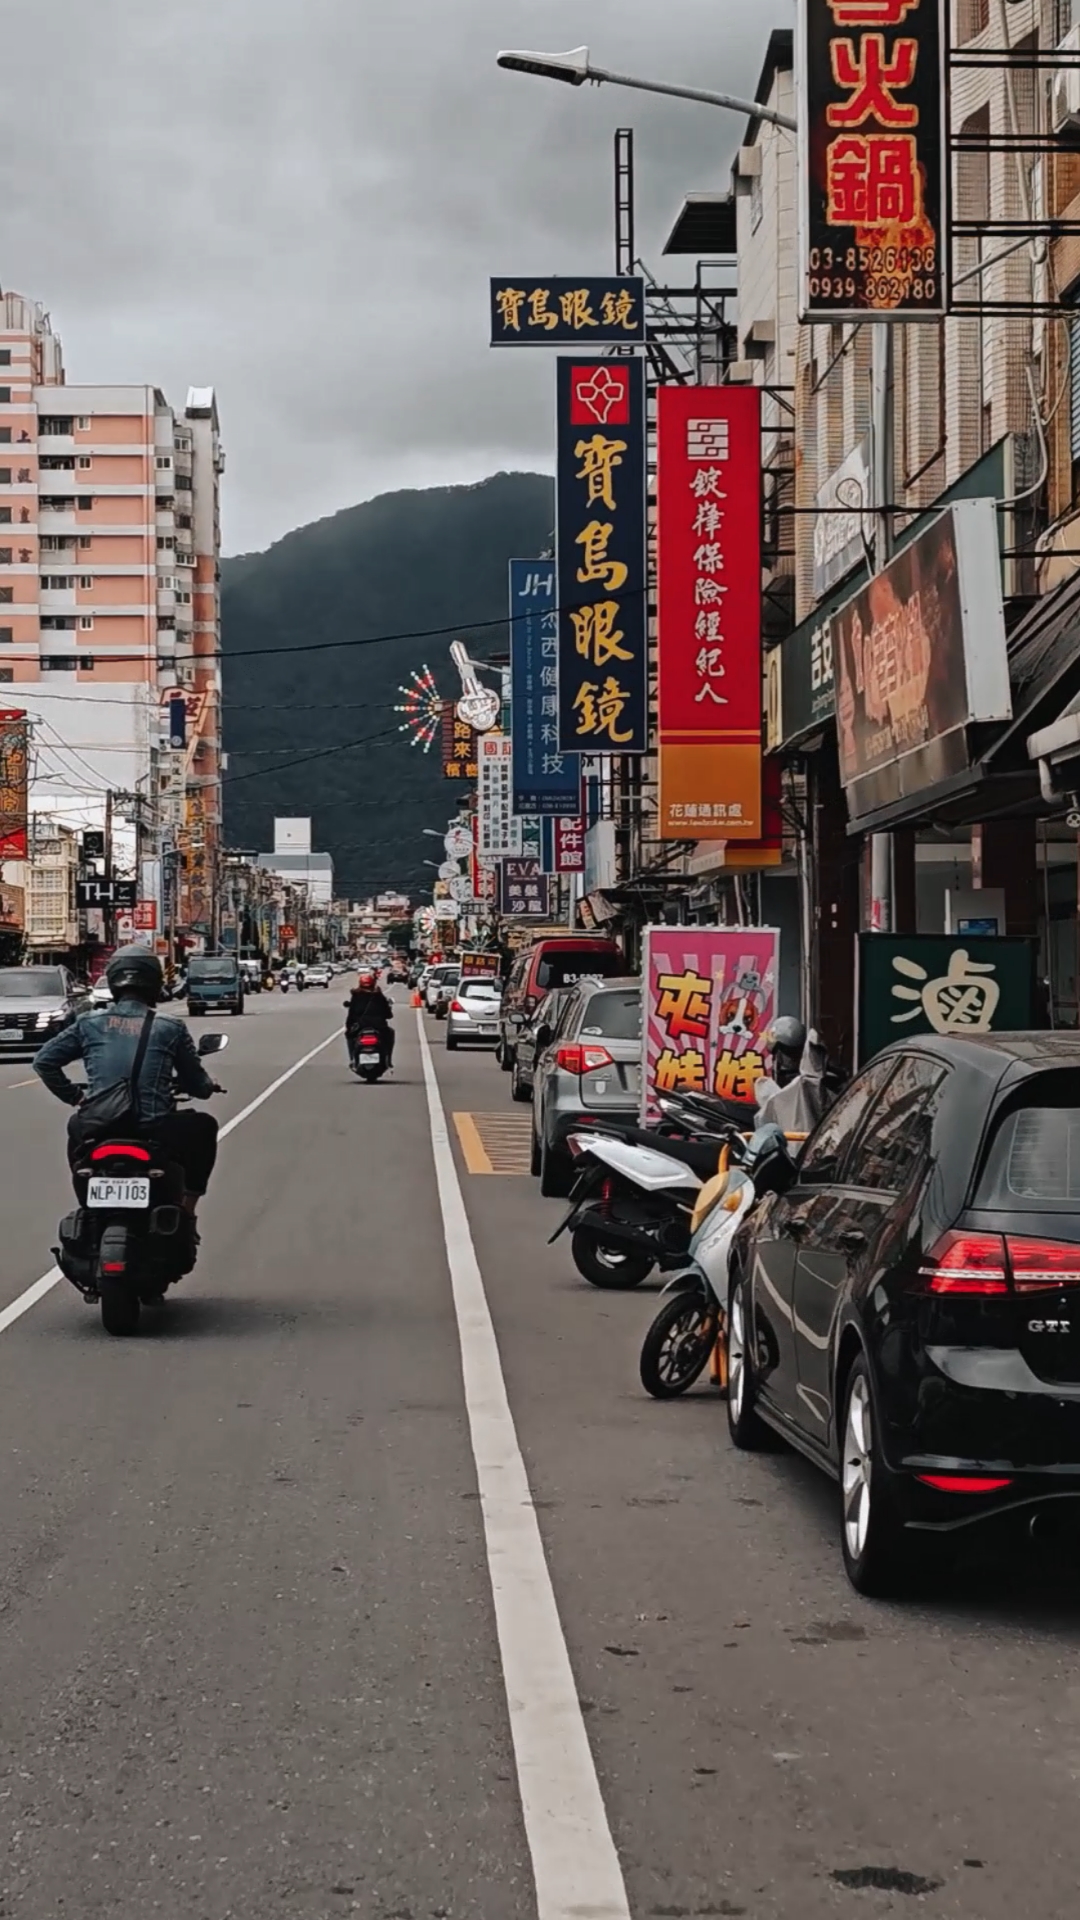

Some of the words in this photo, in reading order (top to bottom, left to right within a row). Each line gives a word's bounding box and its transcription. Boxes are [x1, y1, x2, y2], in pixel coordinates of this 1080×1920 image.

[810, 246, 935, 271] 03-8526138
[496, 287, 638, 332] 寶島眼鏡
[569, 433, 635, 743] 寶島眼鏡
[669, 803, 742, 817] 花蓮通訊處
[655, 969, 713, 1039] 夾
[890, 949, 1000, 1034] 滷
[655, 1048, 766, 1106] 娃娃
[90, 1185, 147, 1200] NLP-1103
[1028, 1319, 1070, 1333] GTI
